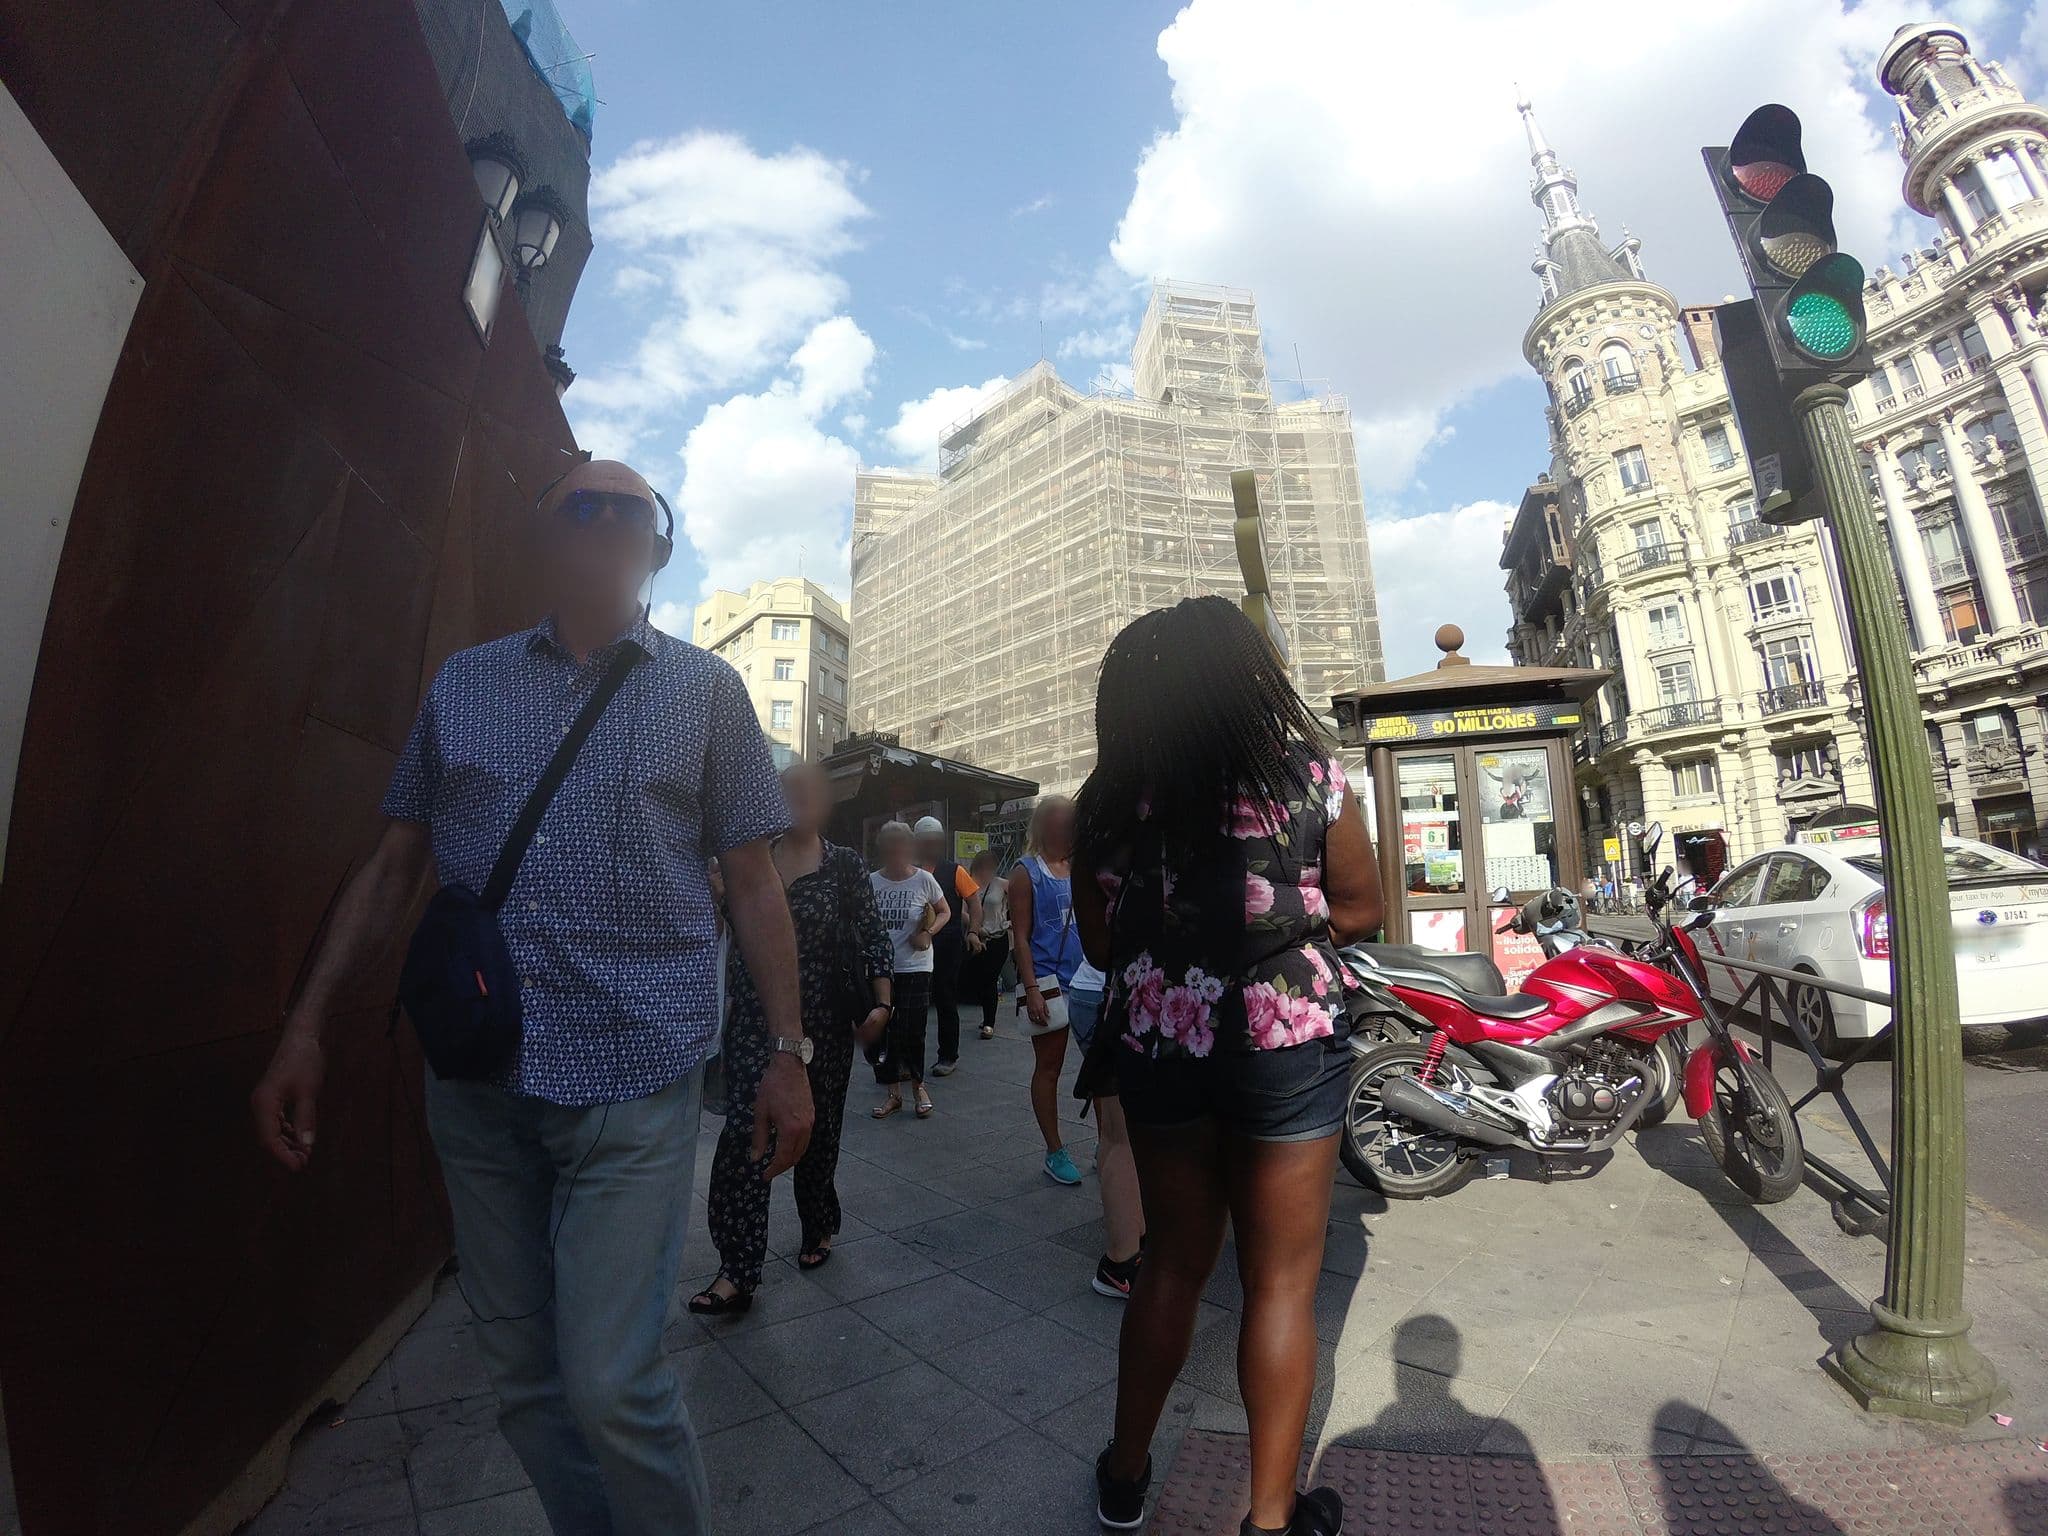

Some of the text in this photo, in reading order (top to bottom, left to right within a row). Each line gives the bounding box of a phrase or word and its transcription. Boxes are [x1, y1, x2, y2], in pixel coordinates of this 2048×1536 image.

[1453, 710, 1477, 719] BOTES
[1487, 707, 1512, 715] HASTA
[1432, 719, 1456, 735] 90
[1457, 712, 1537, 733] MILLONES
[1810, 832, 1829, 844] TAXI
[881, 909, 910, 919] RIGH
